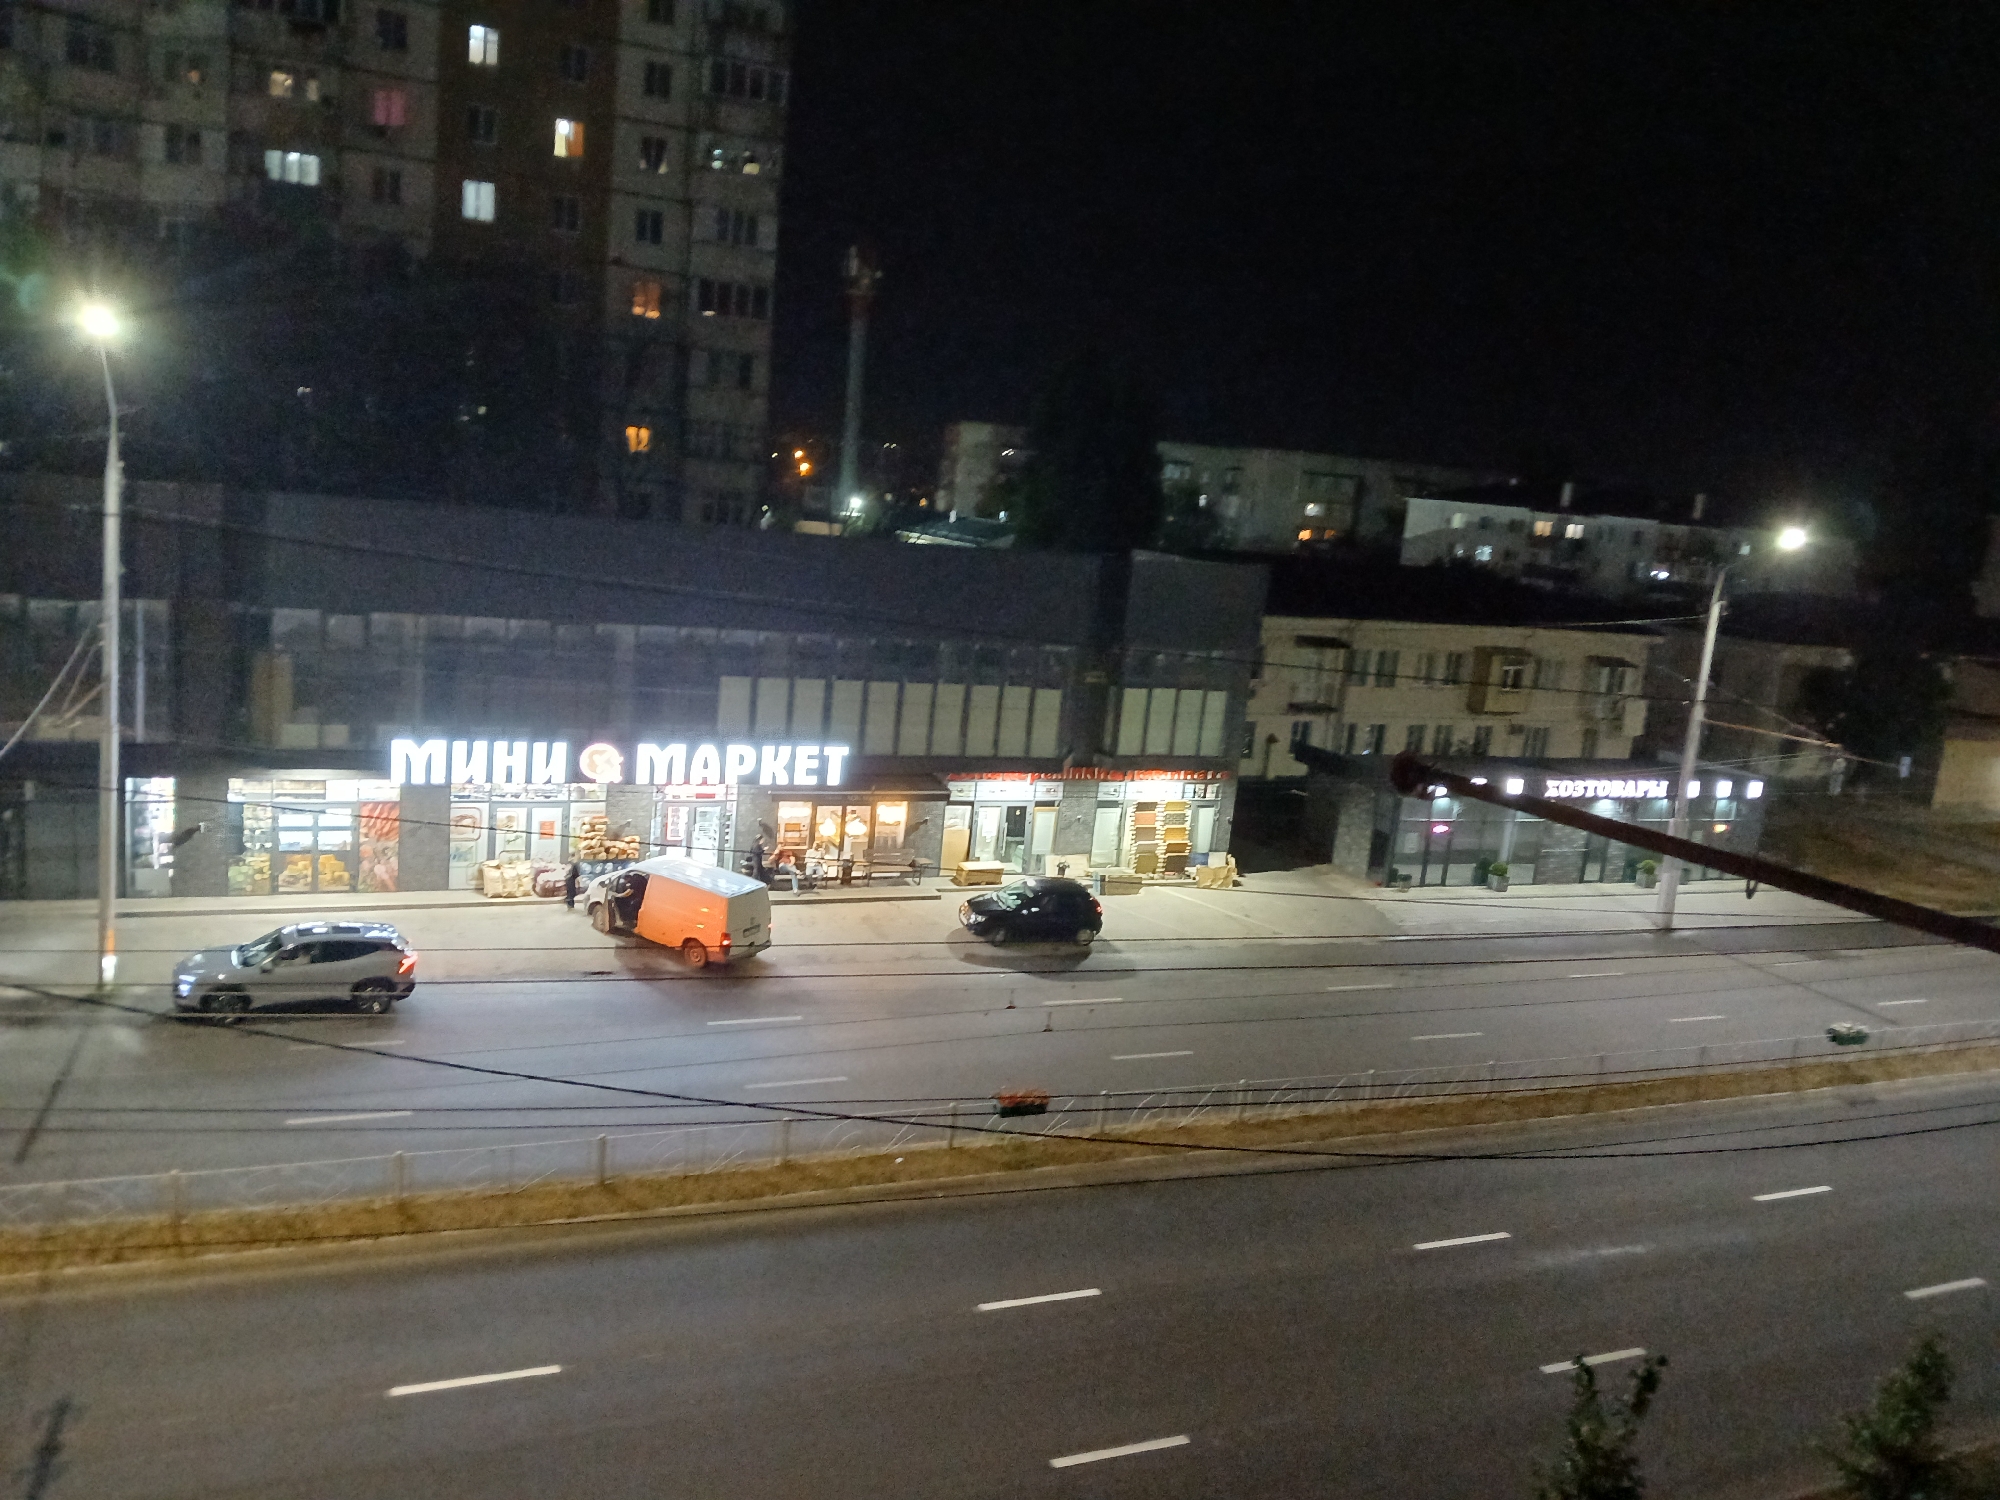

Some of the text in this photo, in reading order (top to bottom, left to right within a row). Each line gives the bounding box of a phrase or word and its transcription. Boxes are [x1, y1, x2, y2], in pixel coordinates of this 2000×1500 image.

[390, 738, 850, 786] МИНИ МАРКЕТ
[1544, 780, 1669, 798] ХОЗТОВАРЫ
